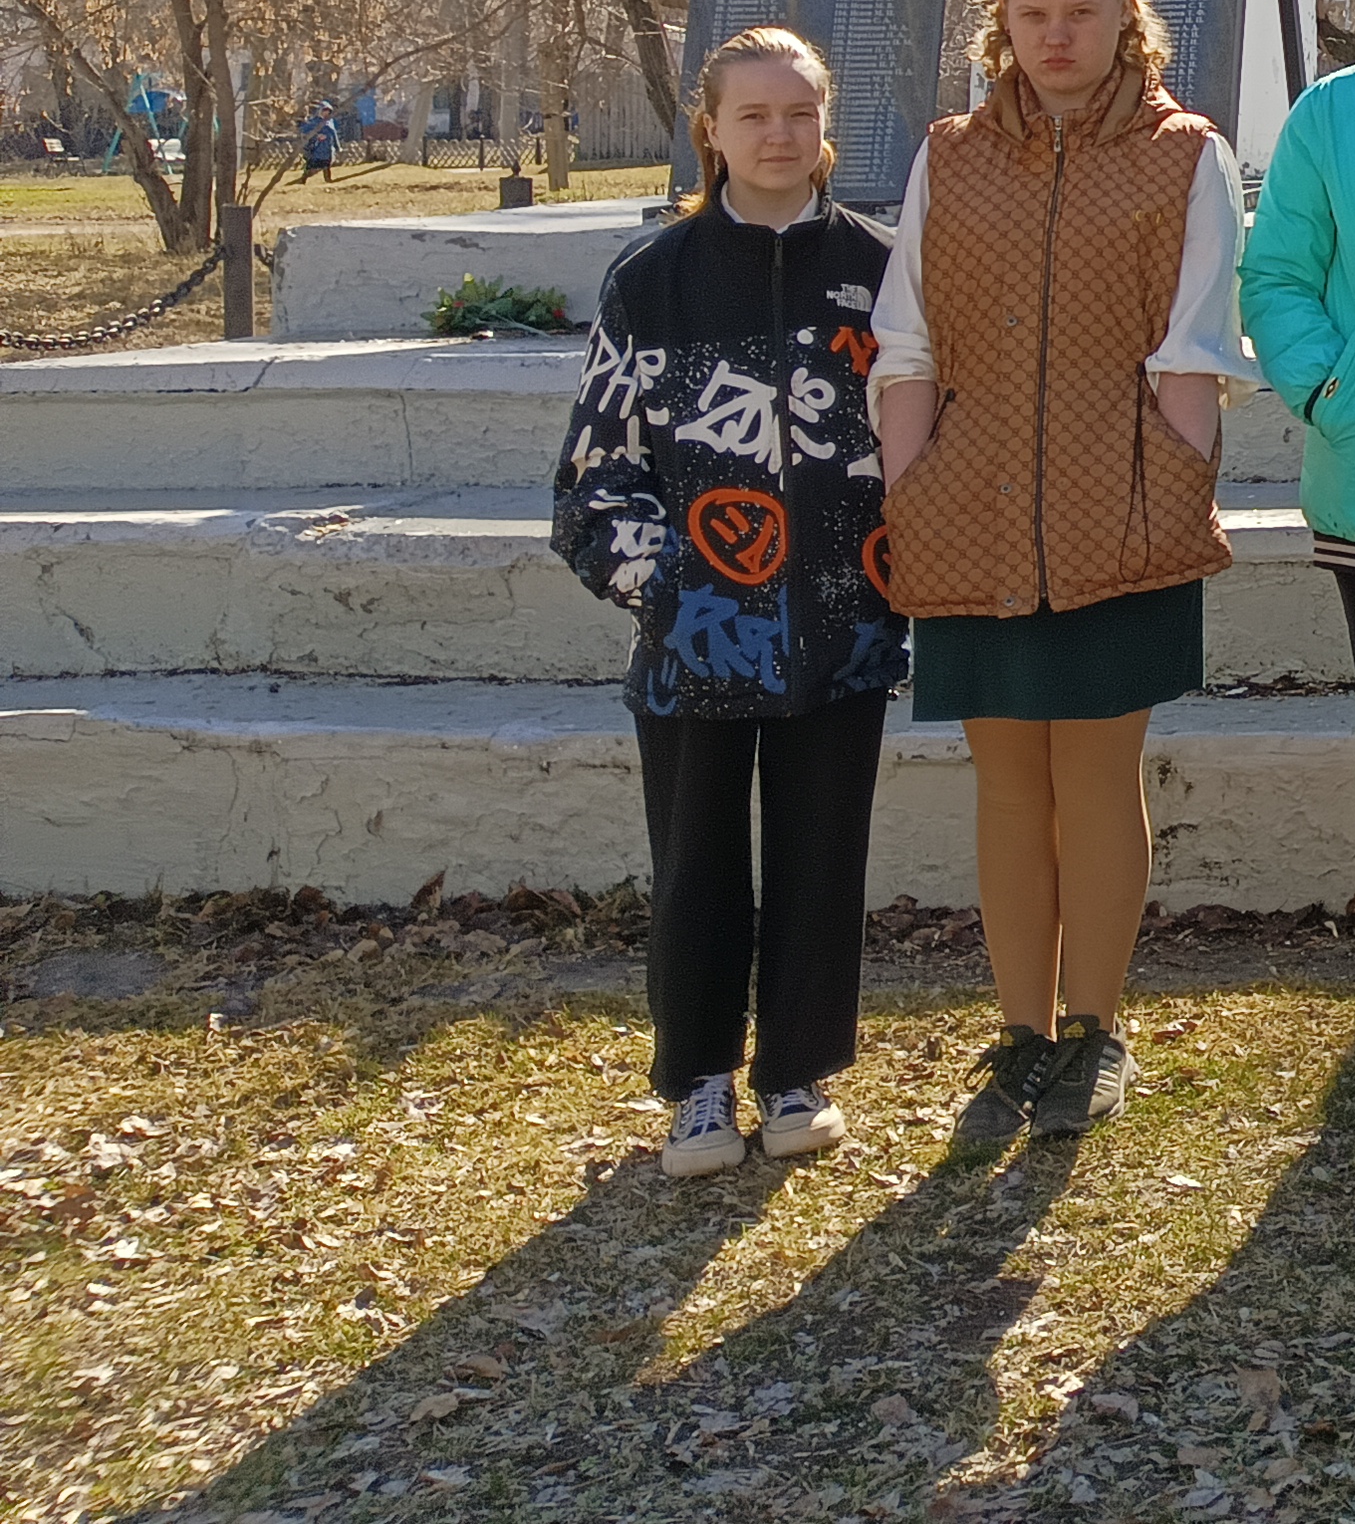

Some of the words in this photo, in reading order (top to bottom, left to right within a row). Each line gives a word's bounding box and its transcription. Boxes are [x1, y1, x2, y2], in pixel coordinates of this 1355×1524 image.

[840, 283, 856, 293] THE
[826, 289, 857, 301] NORTH
[837, 299, 857, 309] FACE
